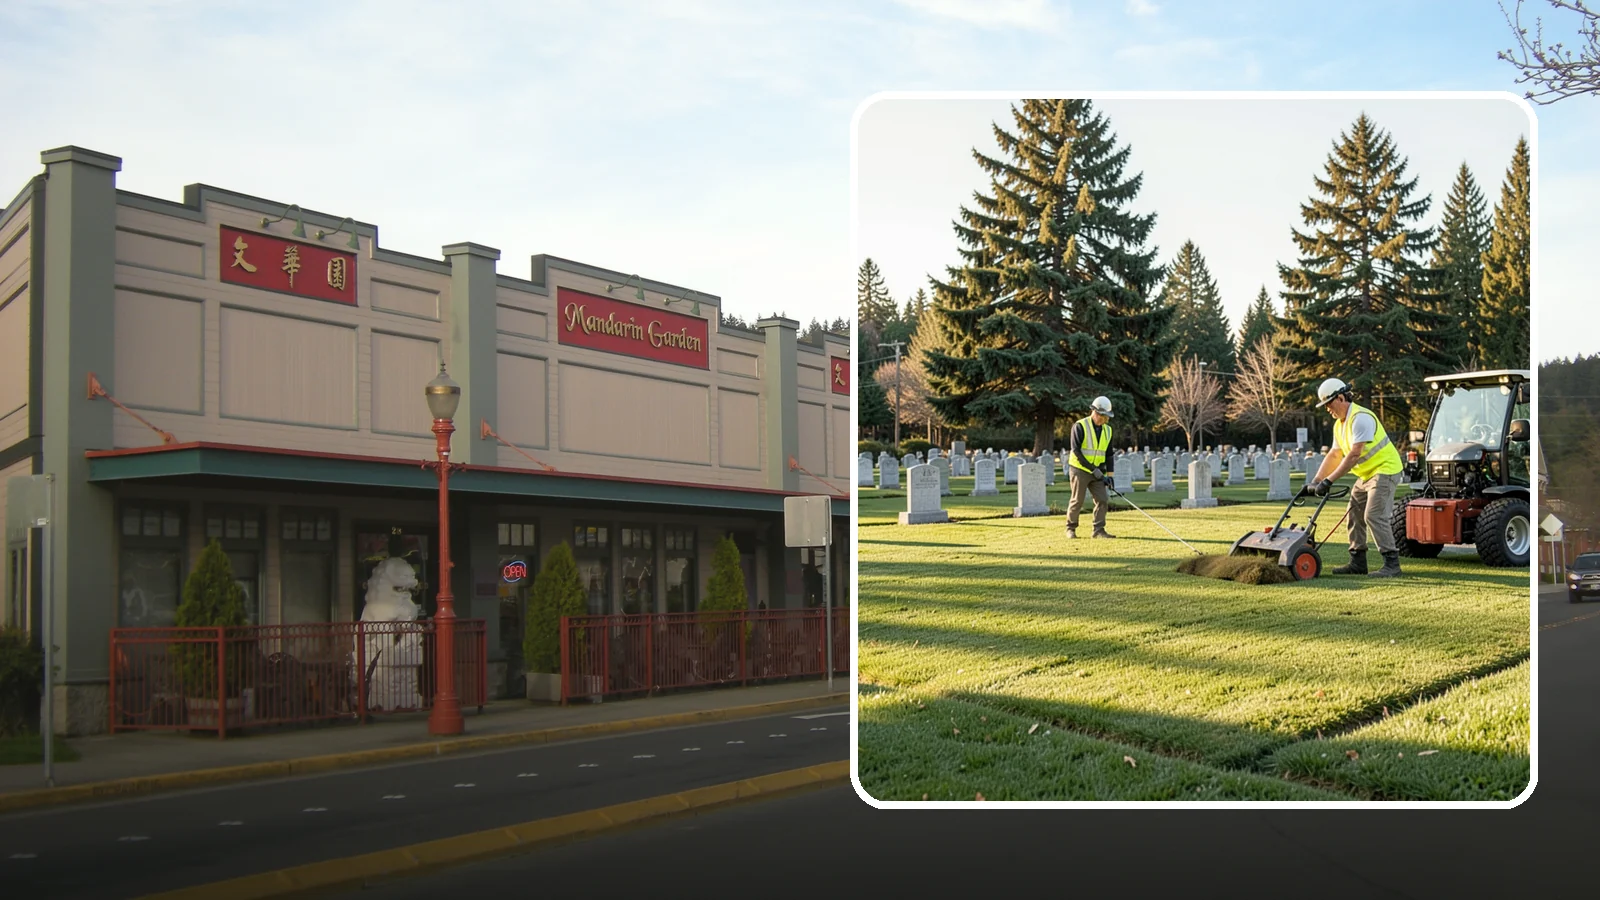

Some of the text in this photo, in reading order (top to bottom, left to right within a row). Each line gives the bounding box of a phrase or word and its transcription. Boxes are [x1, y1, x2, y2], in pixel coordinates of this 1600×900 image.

[231, 235, 346, 291] 文華園
[564, 302, 701, 352] Mandarin Garden
[835, 363, 846, 386] 文
[503, 565, 527, 578] OPEN
